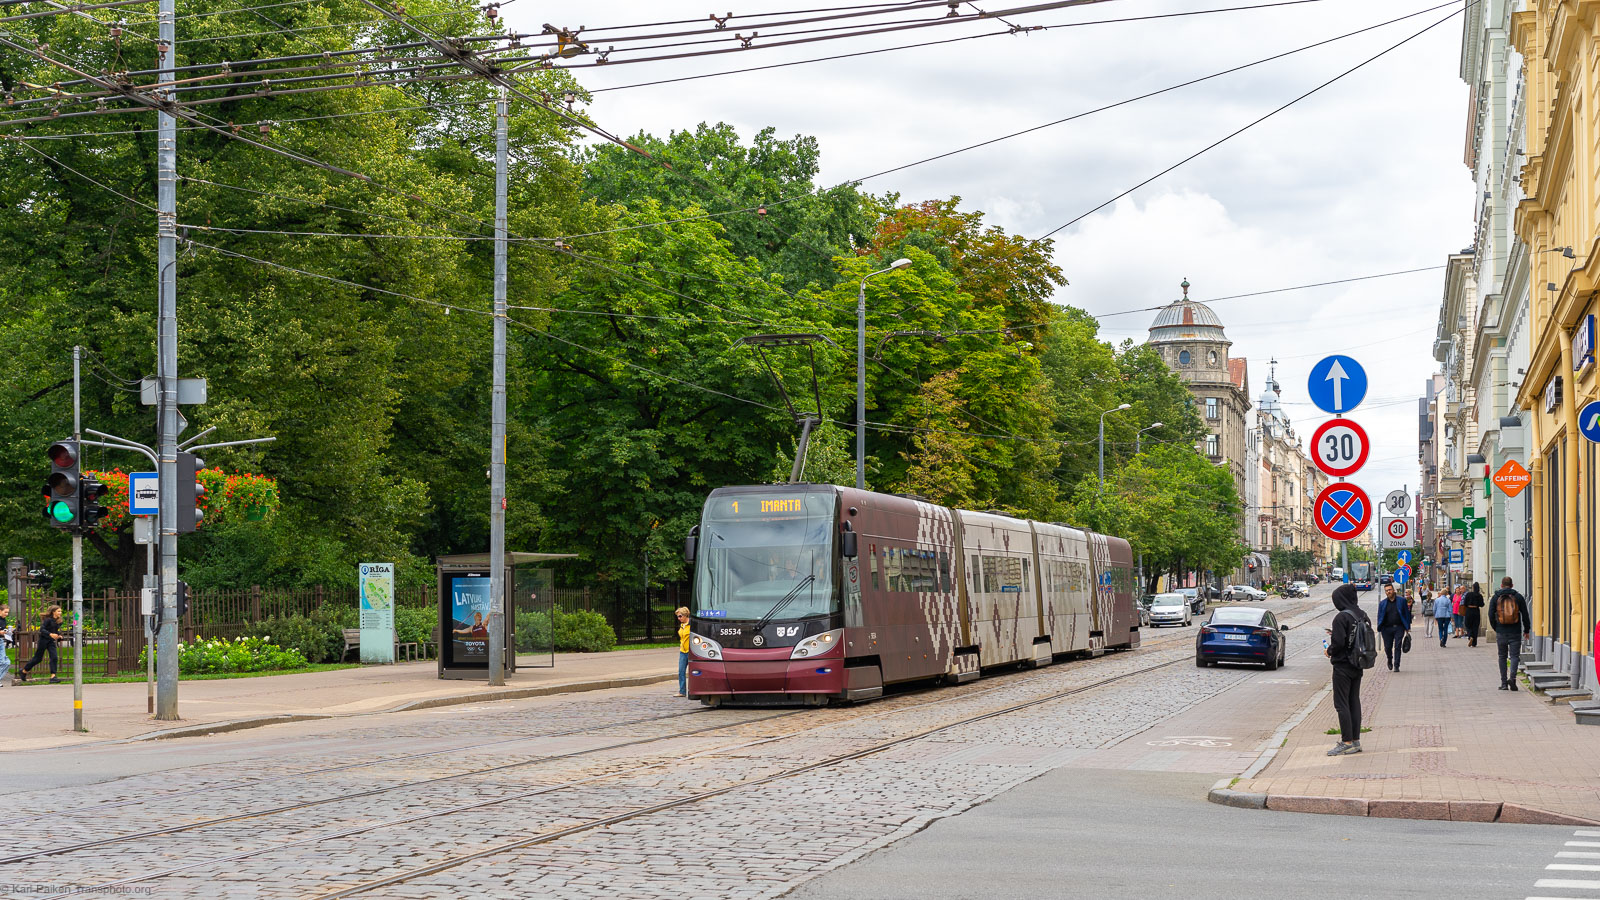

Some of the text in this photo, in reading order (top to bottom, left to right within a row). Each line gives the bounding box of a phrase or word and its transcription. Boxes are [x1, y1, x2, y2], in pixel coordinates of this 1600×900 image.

[1325, 433, 1354, 462] 30
[731, 499, 801, 513] 1 IMANTA
[1391, 496, 1404, 508] 30
[1393, 524, 1403, 534] 30
[720, 628, 741, 636] 58534
